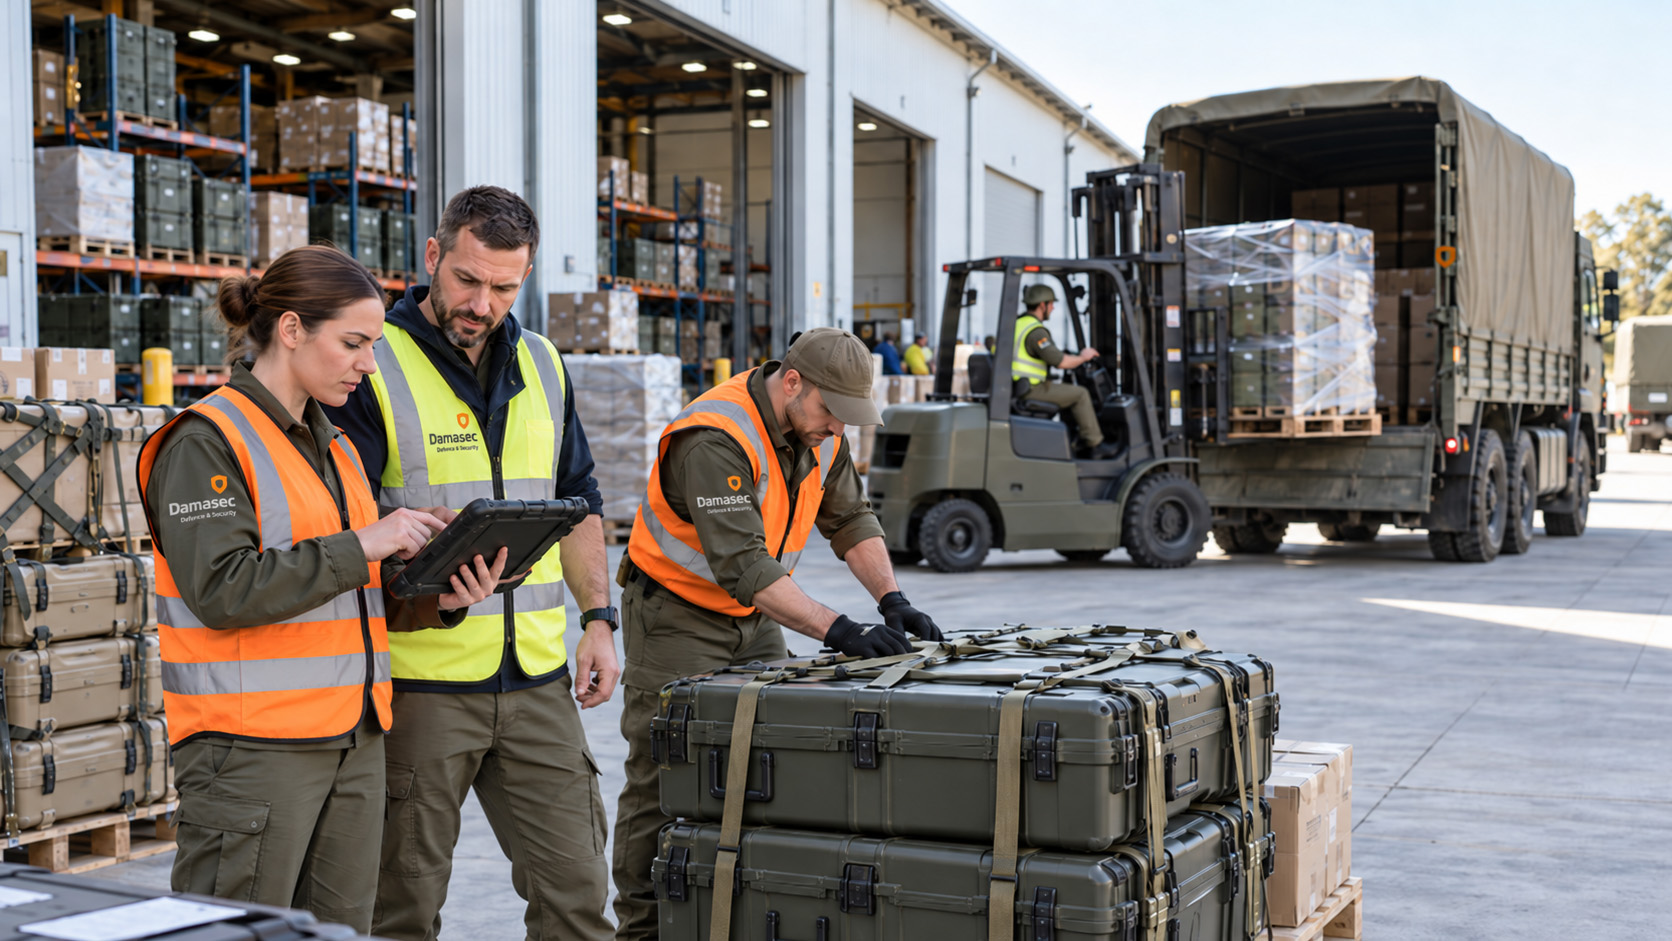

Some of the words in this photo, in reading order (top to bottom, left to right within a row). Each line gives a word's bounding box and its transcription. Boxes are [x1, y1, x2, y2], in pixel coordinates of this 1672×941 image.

[428, 433, 478, 445] Damasec
[168, 497, 236, 516] Damasec
[696, 494, 751, 508] Damasec
